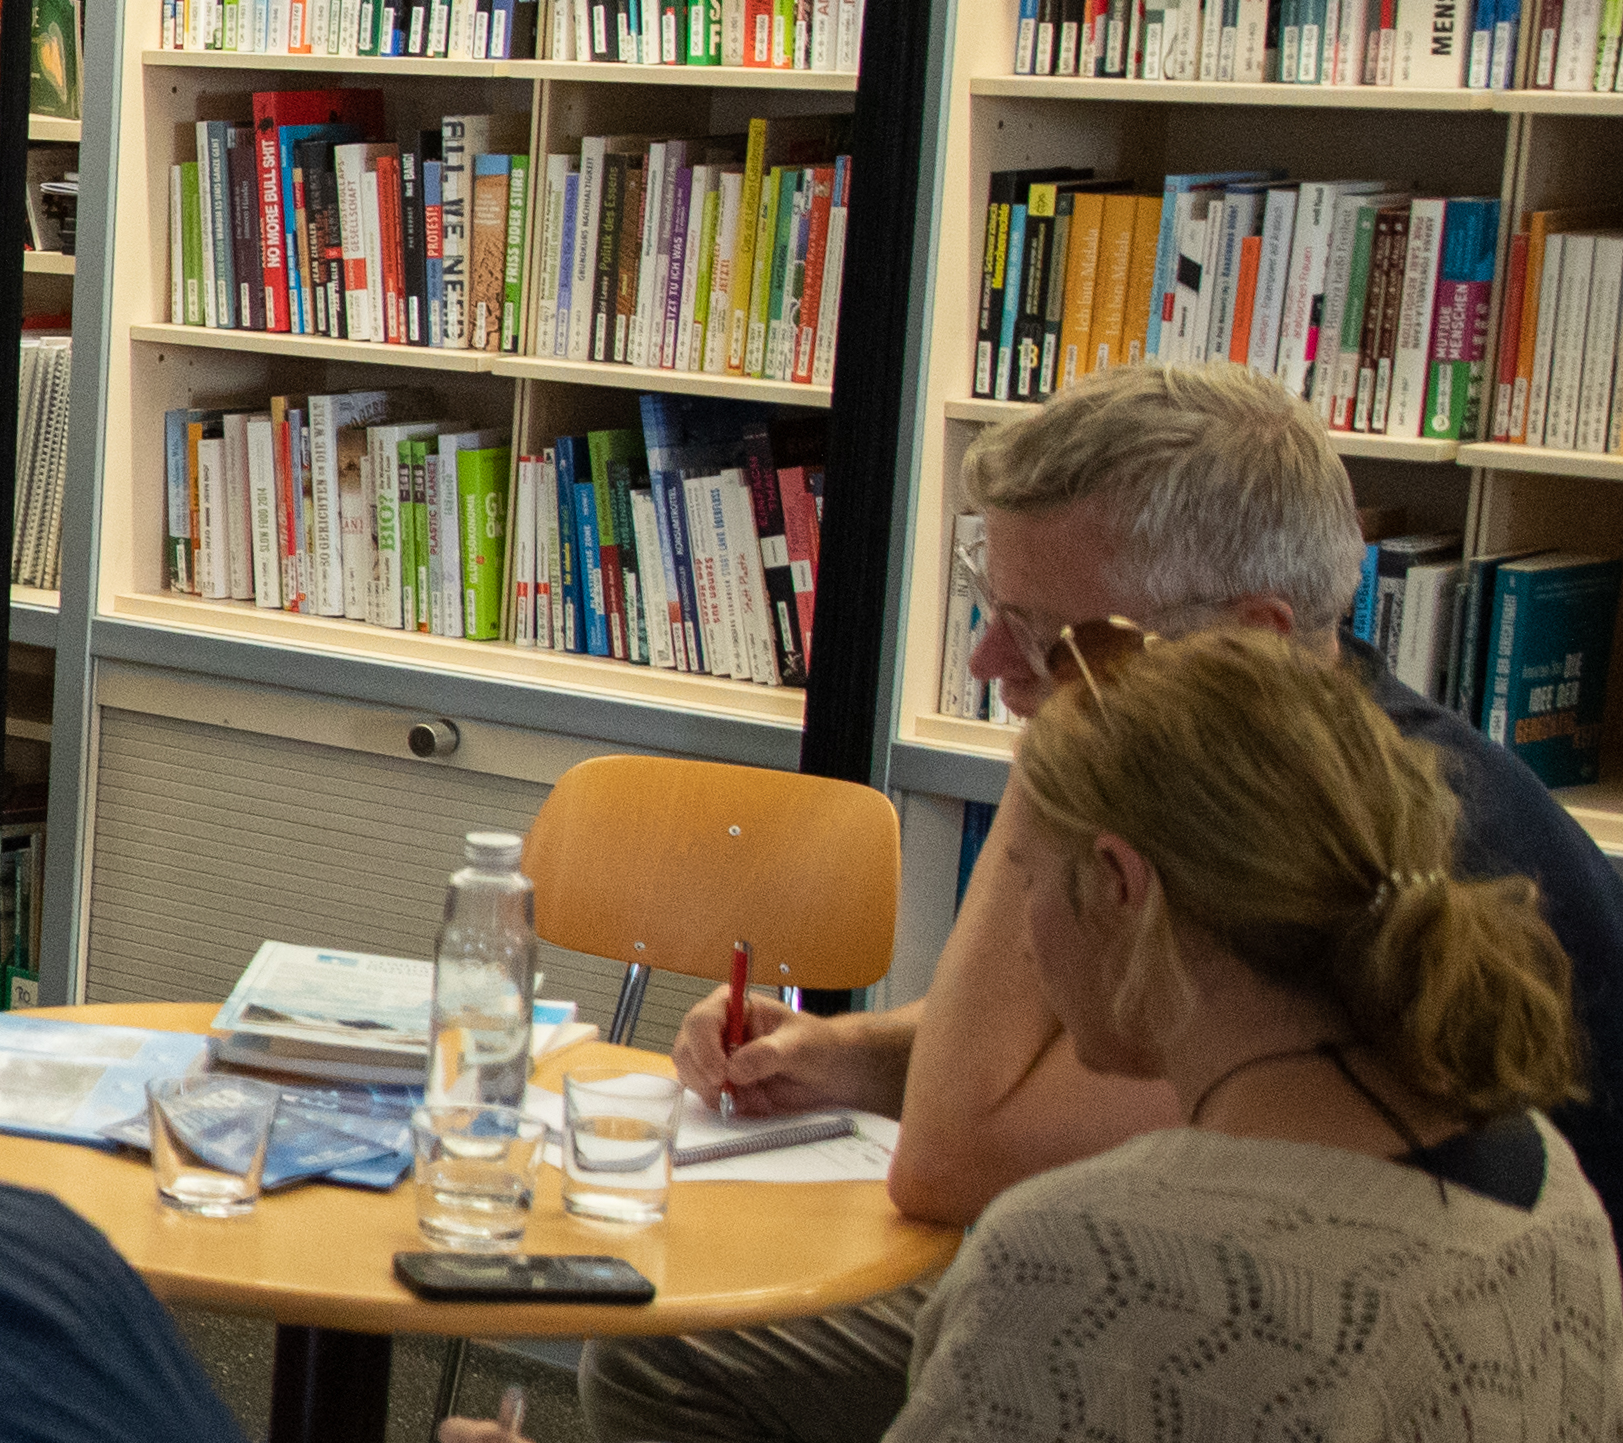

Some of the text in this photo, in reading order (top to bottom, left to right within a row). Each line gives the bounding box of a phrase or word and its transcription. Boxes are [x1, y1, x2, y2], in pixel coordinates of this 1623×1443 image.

[260, 138, 281, 268] NO MORE BULL SHIT
